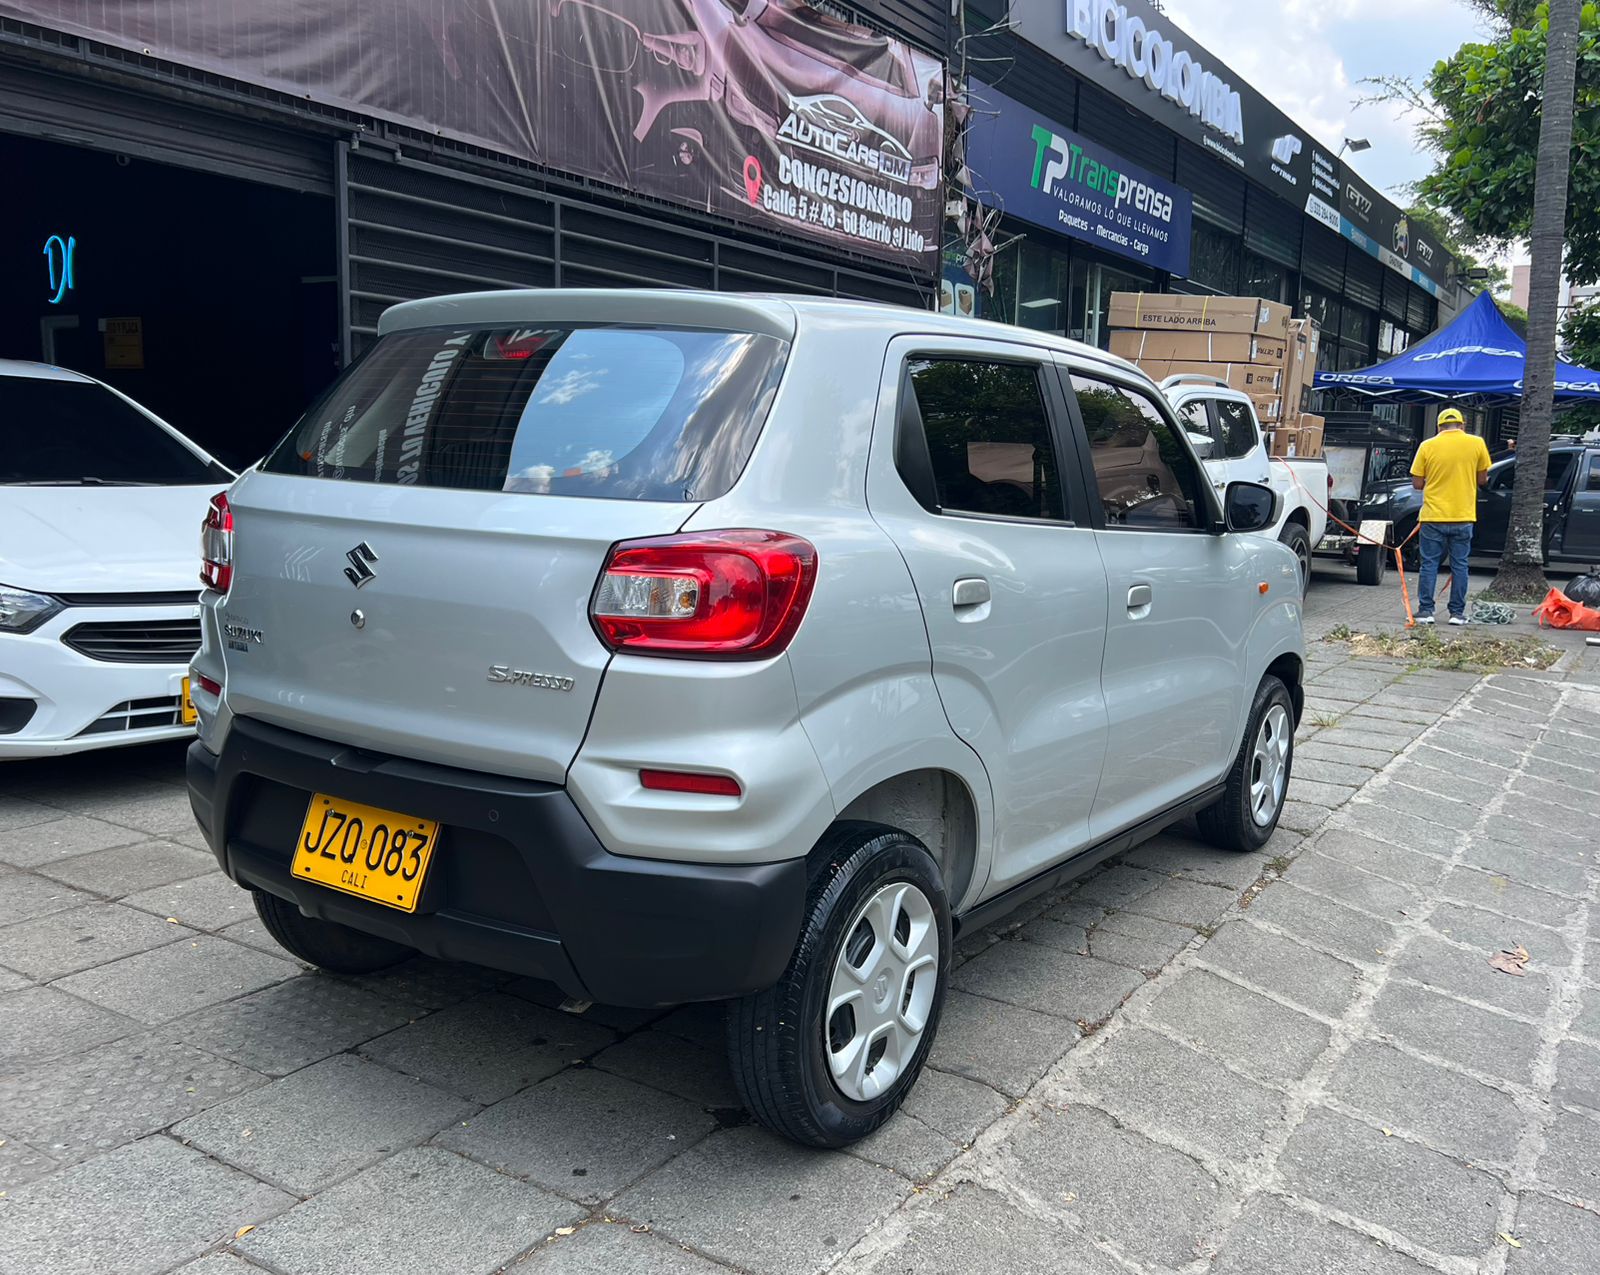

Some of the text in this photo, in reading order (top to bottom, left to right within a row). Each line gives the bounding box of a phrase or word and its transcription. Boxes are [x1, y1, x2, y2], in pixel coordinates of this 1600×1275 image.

[778, 154, 913, 223] CONCESIONARIO
[1069, 143, 1173, 223] Transprensa
[763, 183, 797, 217] Calle
[798, 195, 808, 220] 5
[842, 209, 858, 235] 60
[859, 214, 892, 244] Barrio
[903, 227, 924, 252] Lido
[1053, 185, 1169, 243] VALORAMOS LO QUE LLEVAMOS
[1058, 209, 1088, 232] Paquetes
[1133, 239, 1149, 256] Carga
[1142, 314, 1163, 323] ESTE
[1163, 316, 1185, 325] LADO
[1413, 346, 1524, 362] ORBEA
[1319, 373, 1395, 385] ORBEA
[224, 624, 264, 646] SUZUKI
[341, 869, 368, 889] CALI
